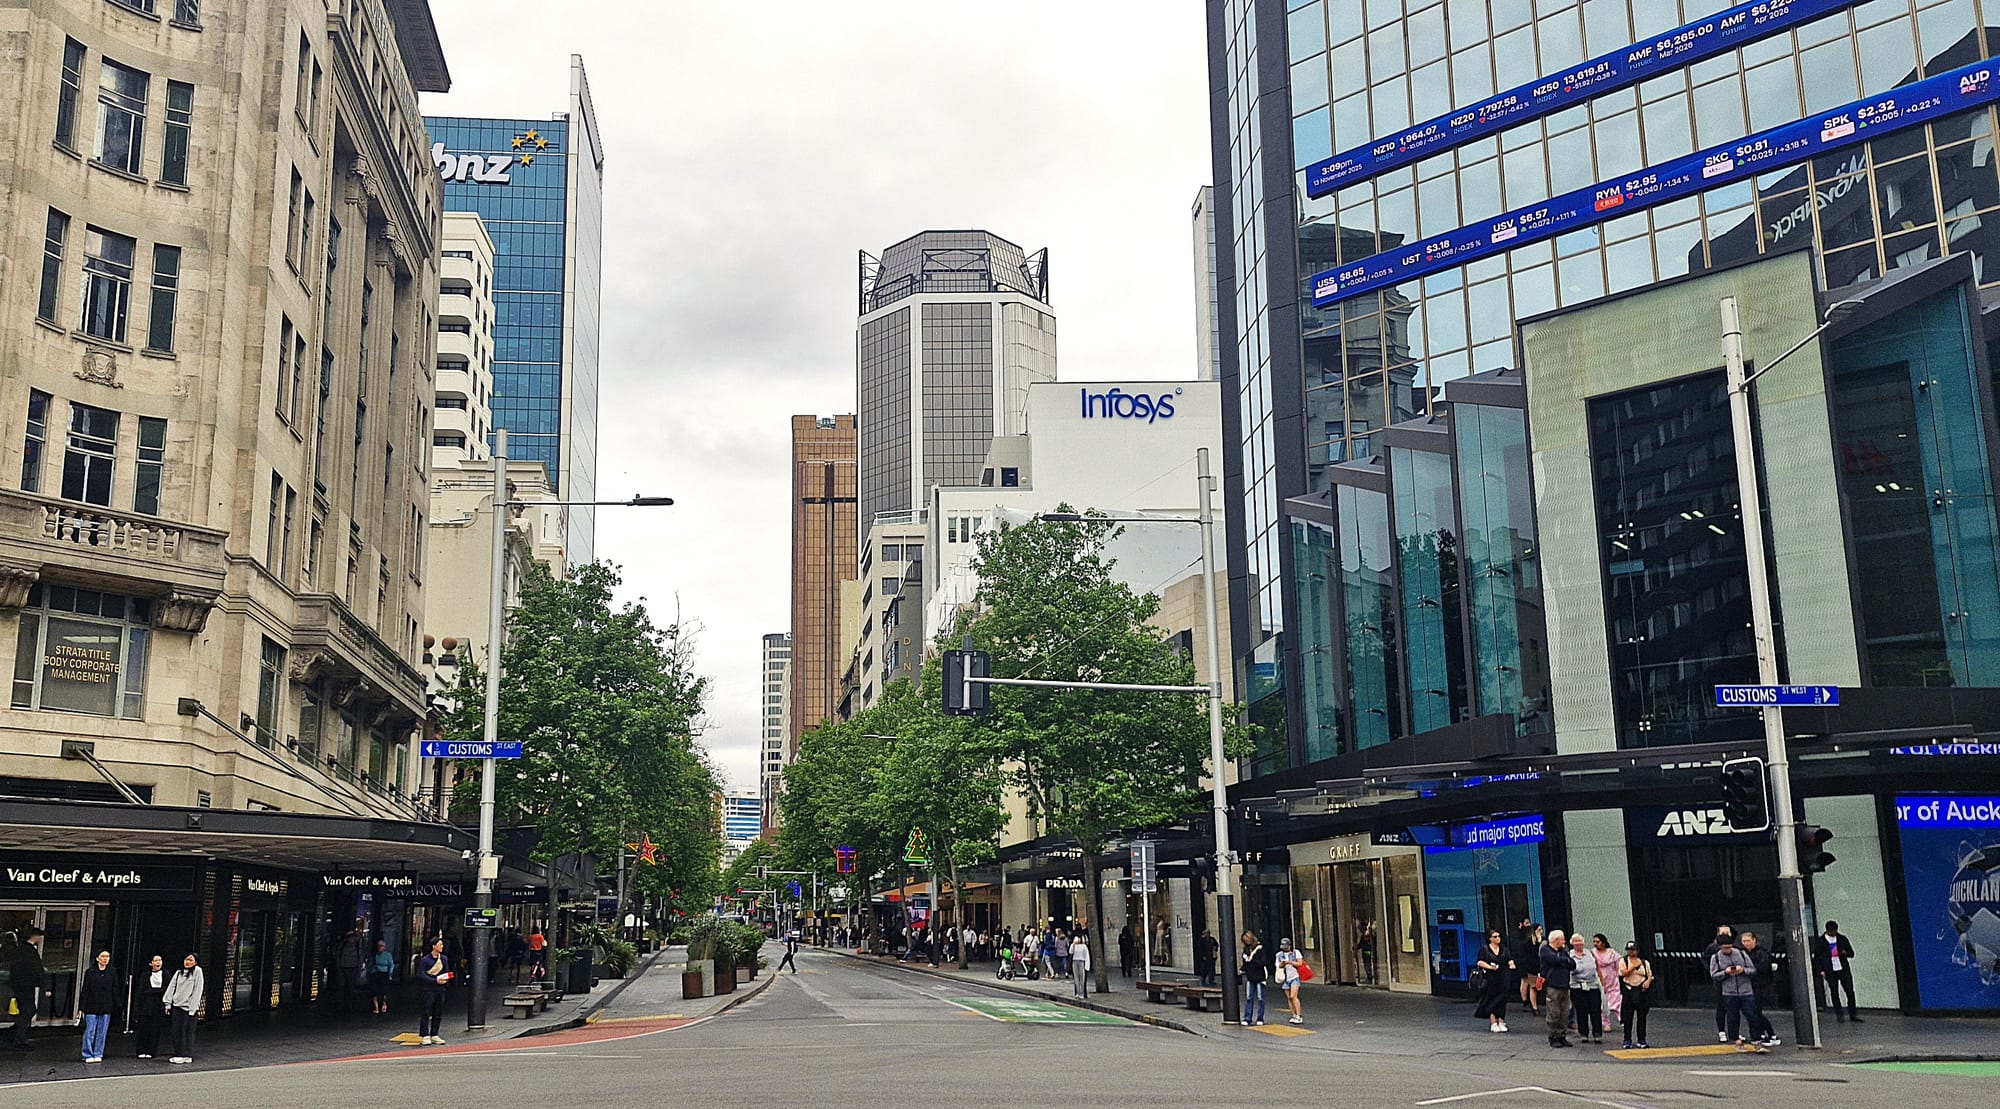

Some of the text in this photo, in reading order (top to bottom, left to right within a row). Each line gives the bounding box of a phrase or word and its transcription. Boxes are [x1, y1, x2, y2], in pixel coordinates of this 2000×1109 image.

[1720, 12, 1746, 29] AMF
[1754, 15, 1767, 25] Apr
[1721, 23, 1747, 38] FUTURE
[1628, 23, 1713, 63] AMF $6,265.00
[1659, 42, 1694, 60] Mar 2026
[1629, 58, 1653, 71] FUTURE
[1533, 61, 1609, 97] NZ50 13,619.81
[1960, 70, 1990, 88] AUD
[1536, 91, 1557, 104] INDEX
[1450, 95, 1517, 128] NZ20 7,797.58
[1823, 99, 1895, 129] SPK $2.32
[1869, 109, 1899, 125] +0.005
[1905, 101, 1931, 114] +0.22
[1932, 97, 1941, 105] %
[1453, 122, 1473, 134] INDEX
[1373, 124, 1437, 156] NZ10 1,964.07
[1375, 152, 1394, 163] INDEX
[1705, 139, 1768, 166] SKC $0.81
[1746, 150, 1773, 162] +0.025
[1780, 141, 1800, 152] +3.18
[1800, 138, 1809, 146] %
[432, 143, 513, 181] bnz
[1321, 159, 1353, 175] 3:09pm
[1320, 170, 1347, 184] November
[1348, 163, 1363, 174] 2025
[1596, 174, 1657, 200] RYM $2.95
[1634, 185, 1658, 197] -0.040
[1663, 177, 1682, 189] -1.34
[1683, 175, 1690, 183] %
[1493, 208, 1548, 233] USV $6.57
[1528, 218, 1550, 230] +0.072
[1402, 239, 1450, 266] UST $3.18
[1317, 267, 1365, 288] USS $8.65
[1081, 388, 1175, 424] Infosys
[56, 645, 112, 661] STRATA TITLE
[44, 656, 120, 673] BODY CORPORATE
[51, 668, 111, 684] MANAGEMENT
[1722, 688, 1777, 703] CUSTOMS
[1781, 686, 1807, 694] ST WEST
[448, 743, 492, 755] CUSTOMS
[1917, 801, 1940, 821] of
[1657, 809, 1731, 837] ANZ
[1379, 834, 1400, 843] ANZ
[1479, 824, 1506, 845] major
[1329, 843, 1360, 860] GRAFF
[7, 868, 141, 887] Van Cleef & Arpels
[324, 876, 412, 888] Van Cleef & Arpels
[1045, 879, 1084, 889] PRADA
